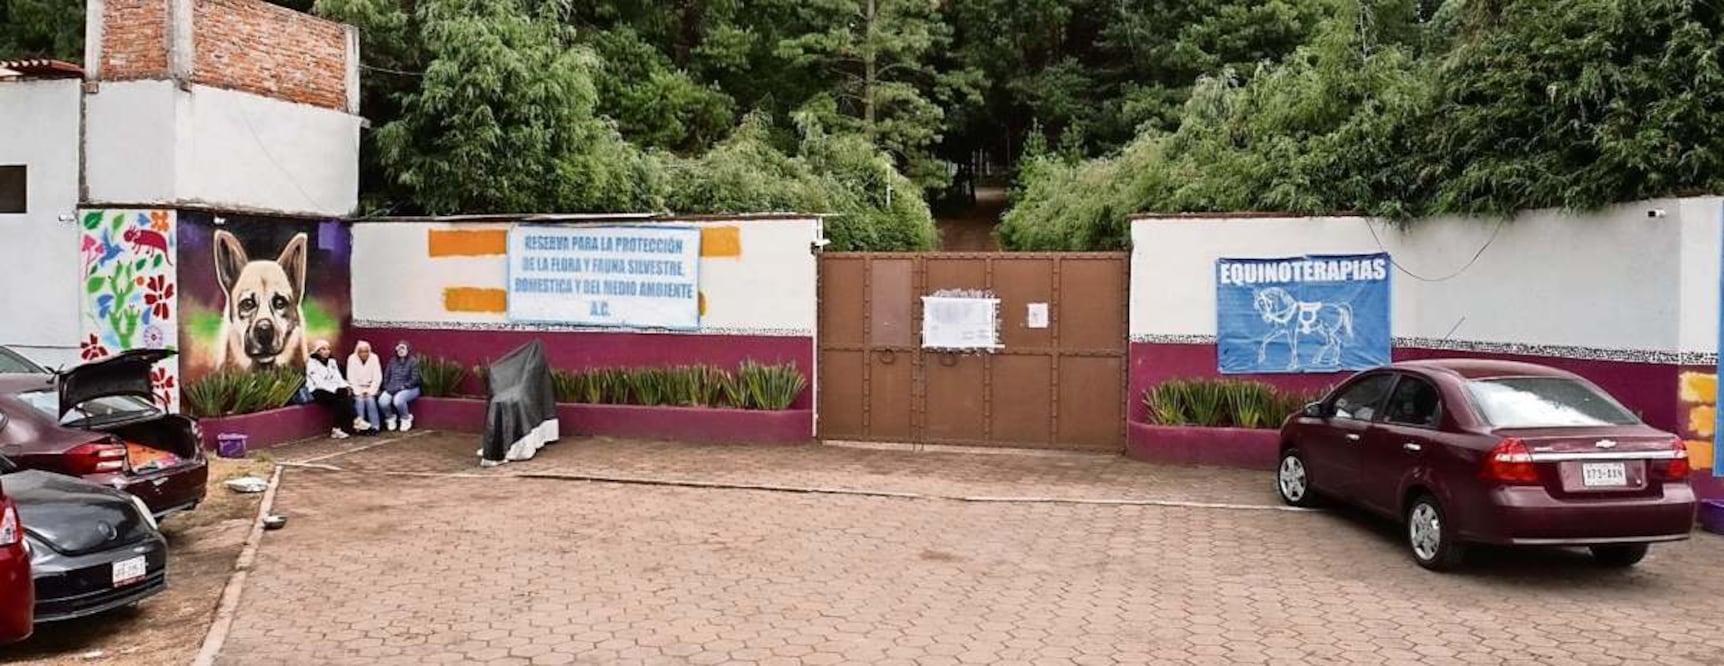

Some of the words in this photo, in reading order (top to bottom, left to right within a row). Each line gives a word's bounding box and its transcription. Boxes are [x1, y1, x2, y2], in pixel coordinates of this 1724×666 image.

[525, 235, 569, 250] RESERVA
[572, 236, 598, 251] PARA
[601, 236, 614, 251] LA
[616, 236, 683, 254] PROTECCIÓN
[522, 257, 535, 271] DE
[537, 257, 549, 271] LA
[551, 257, 582, 272] FLORA
[583, 258, 590, 272] Y
[592, 258, 625, 274] FAUNA
[1221, 259, 1386, 285] EQUINOTERAPIAS
[515, 277, 573, 293] DOMESTICA
[575, 278, 582, 293] Y
[583, 279, 600, 294] DEL
[604, 280, 636, 296] MEDIO
[639, 281, 693, 299] AMBIENTE
[590, 300, 611, 316] A.C.
